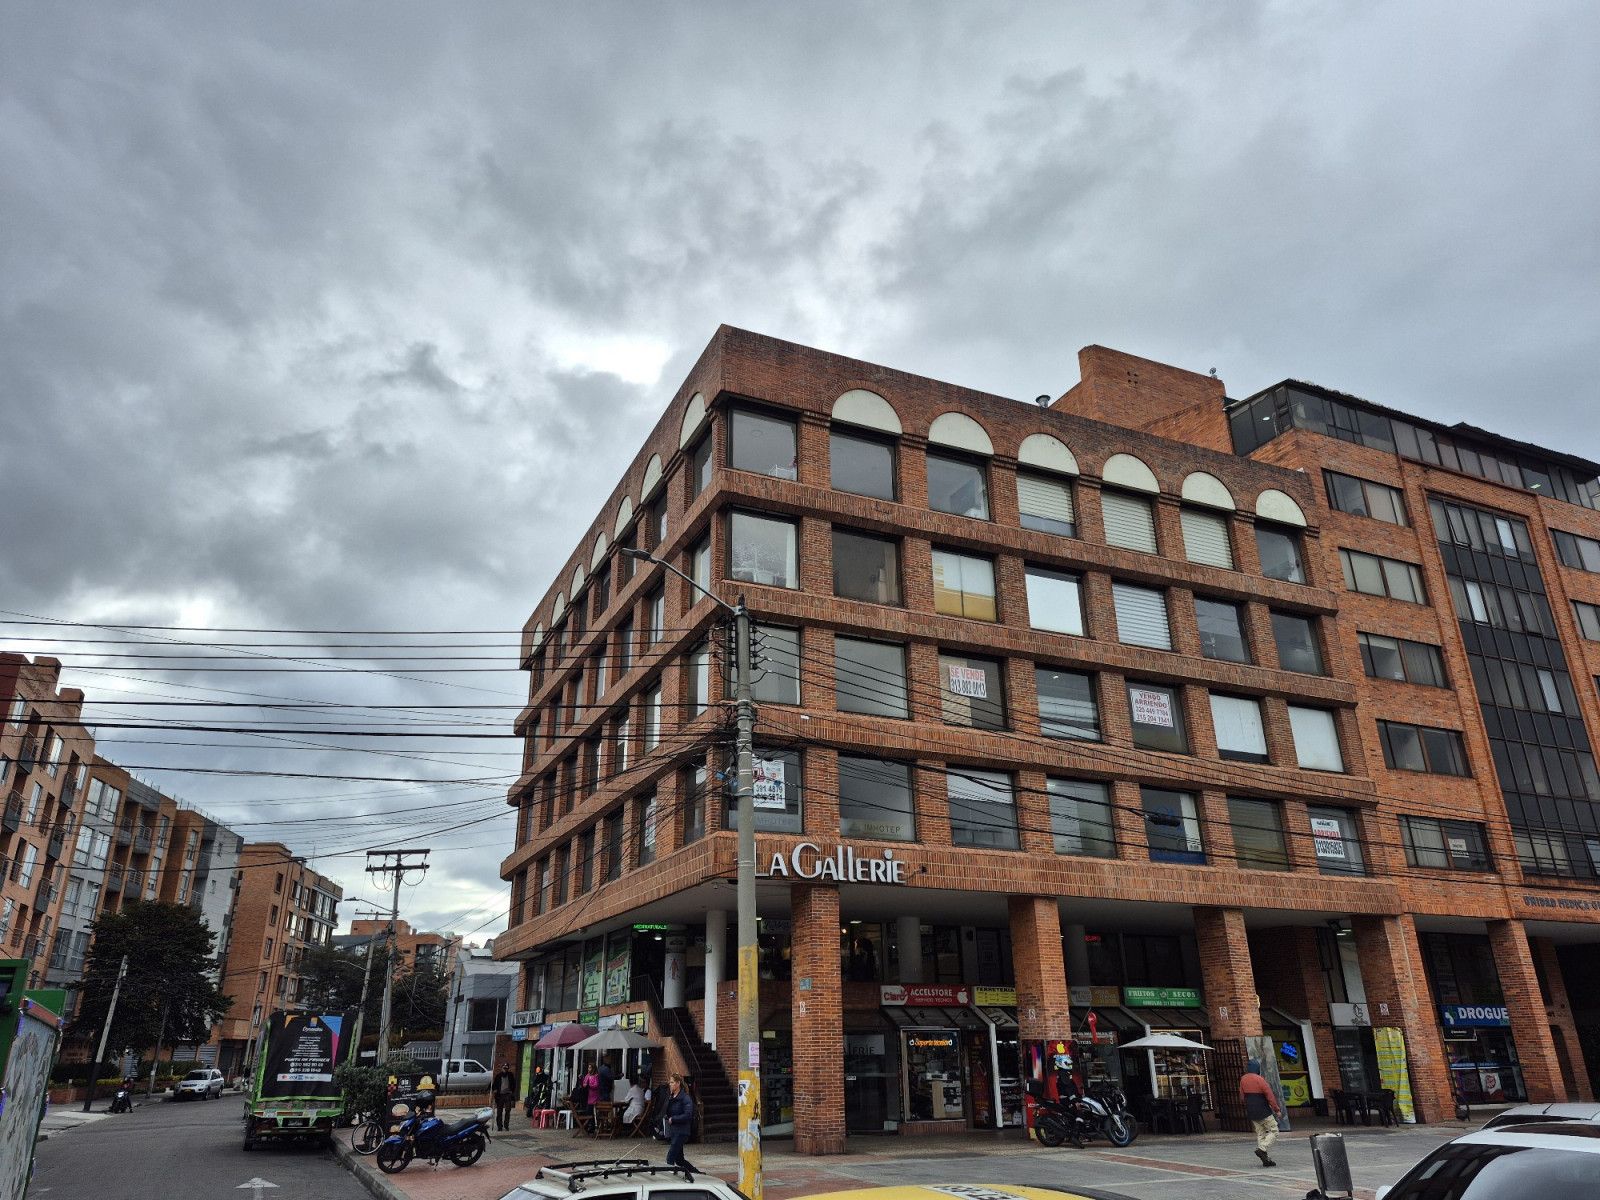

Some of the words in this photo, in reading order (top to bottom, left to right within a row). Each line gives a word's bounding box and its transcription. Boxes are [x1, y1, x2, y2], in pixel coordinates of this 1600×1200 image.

[951, 667, 960, 679] SE
[961, 668, 985, 682] VENDE
[1139, 692, 1161, 701] VENDO
[1135, 699, 1167, 709] ARRIENDO
[864, 823, 901, 834] IMHOTEP
[910, 988, 952, 997] ACCELSTORE
